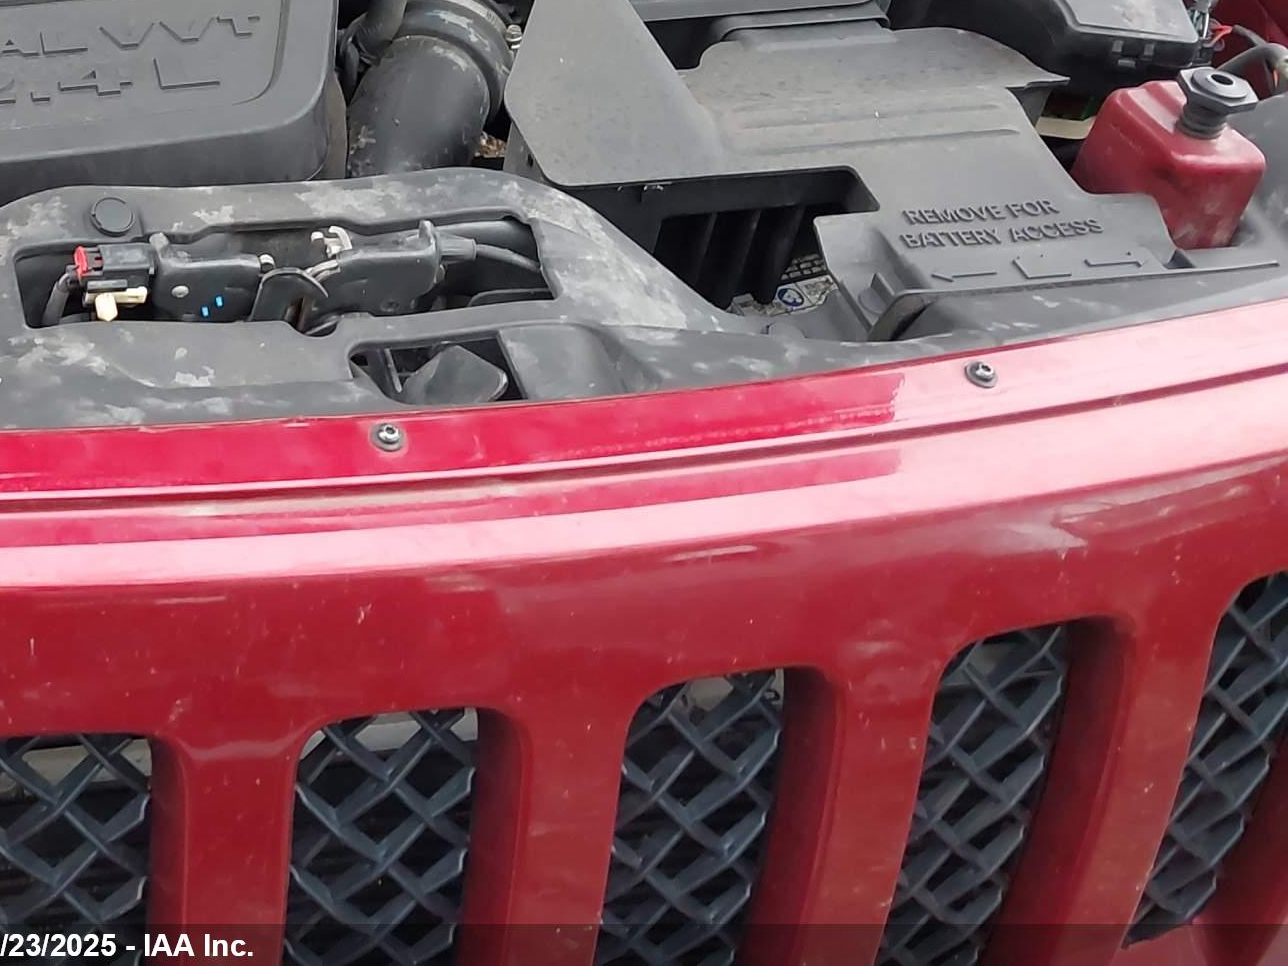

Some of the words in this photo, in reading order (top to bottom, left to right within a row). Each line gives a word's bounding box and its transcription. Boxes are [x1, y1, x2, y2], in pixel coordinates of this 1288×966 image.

[98, 14, 262, 49] VVT
[902, 206, 1006, 226] REMOVE
[1006, 199, 1060, 219] FOR
[900, 228, 1002, 249] BATTERY
[1009, 218, 1104, 243] ACCESS
